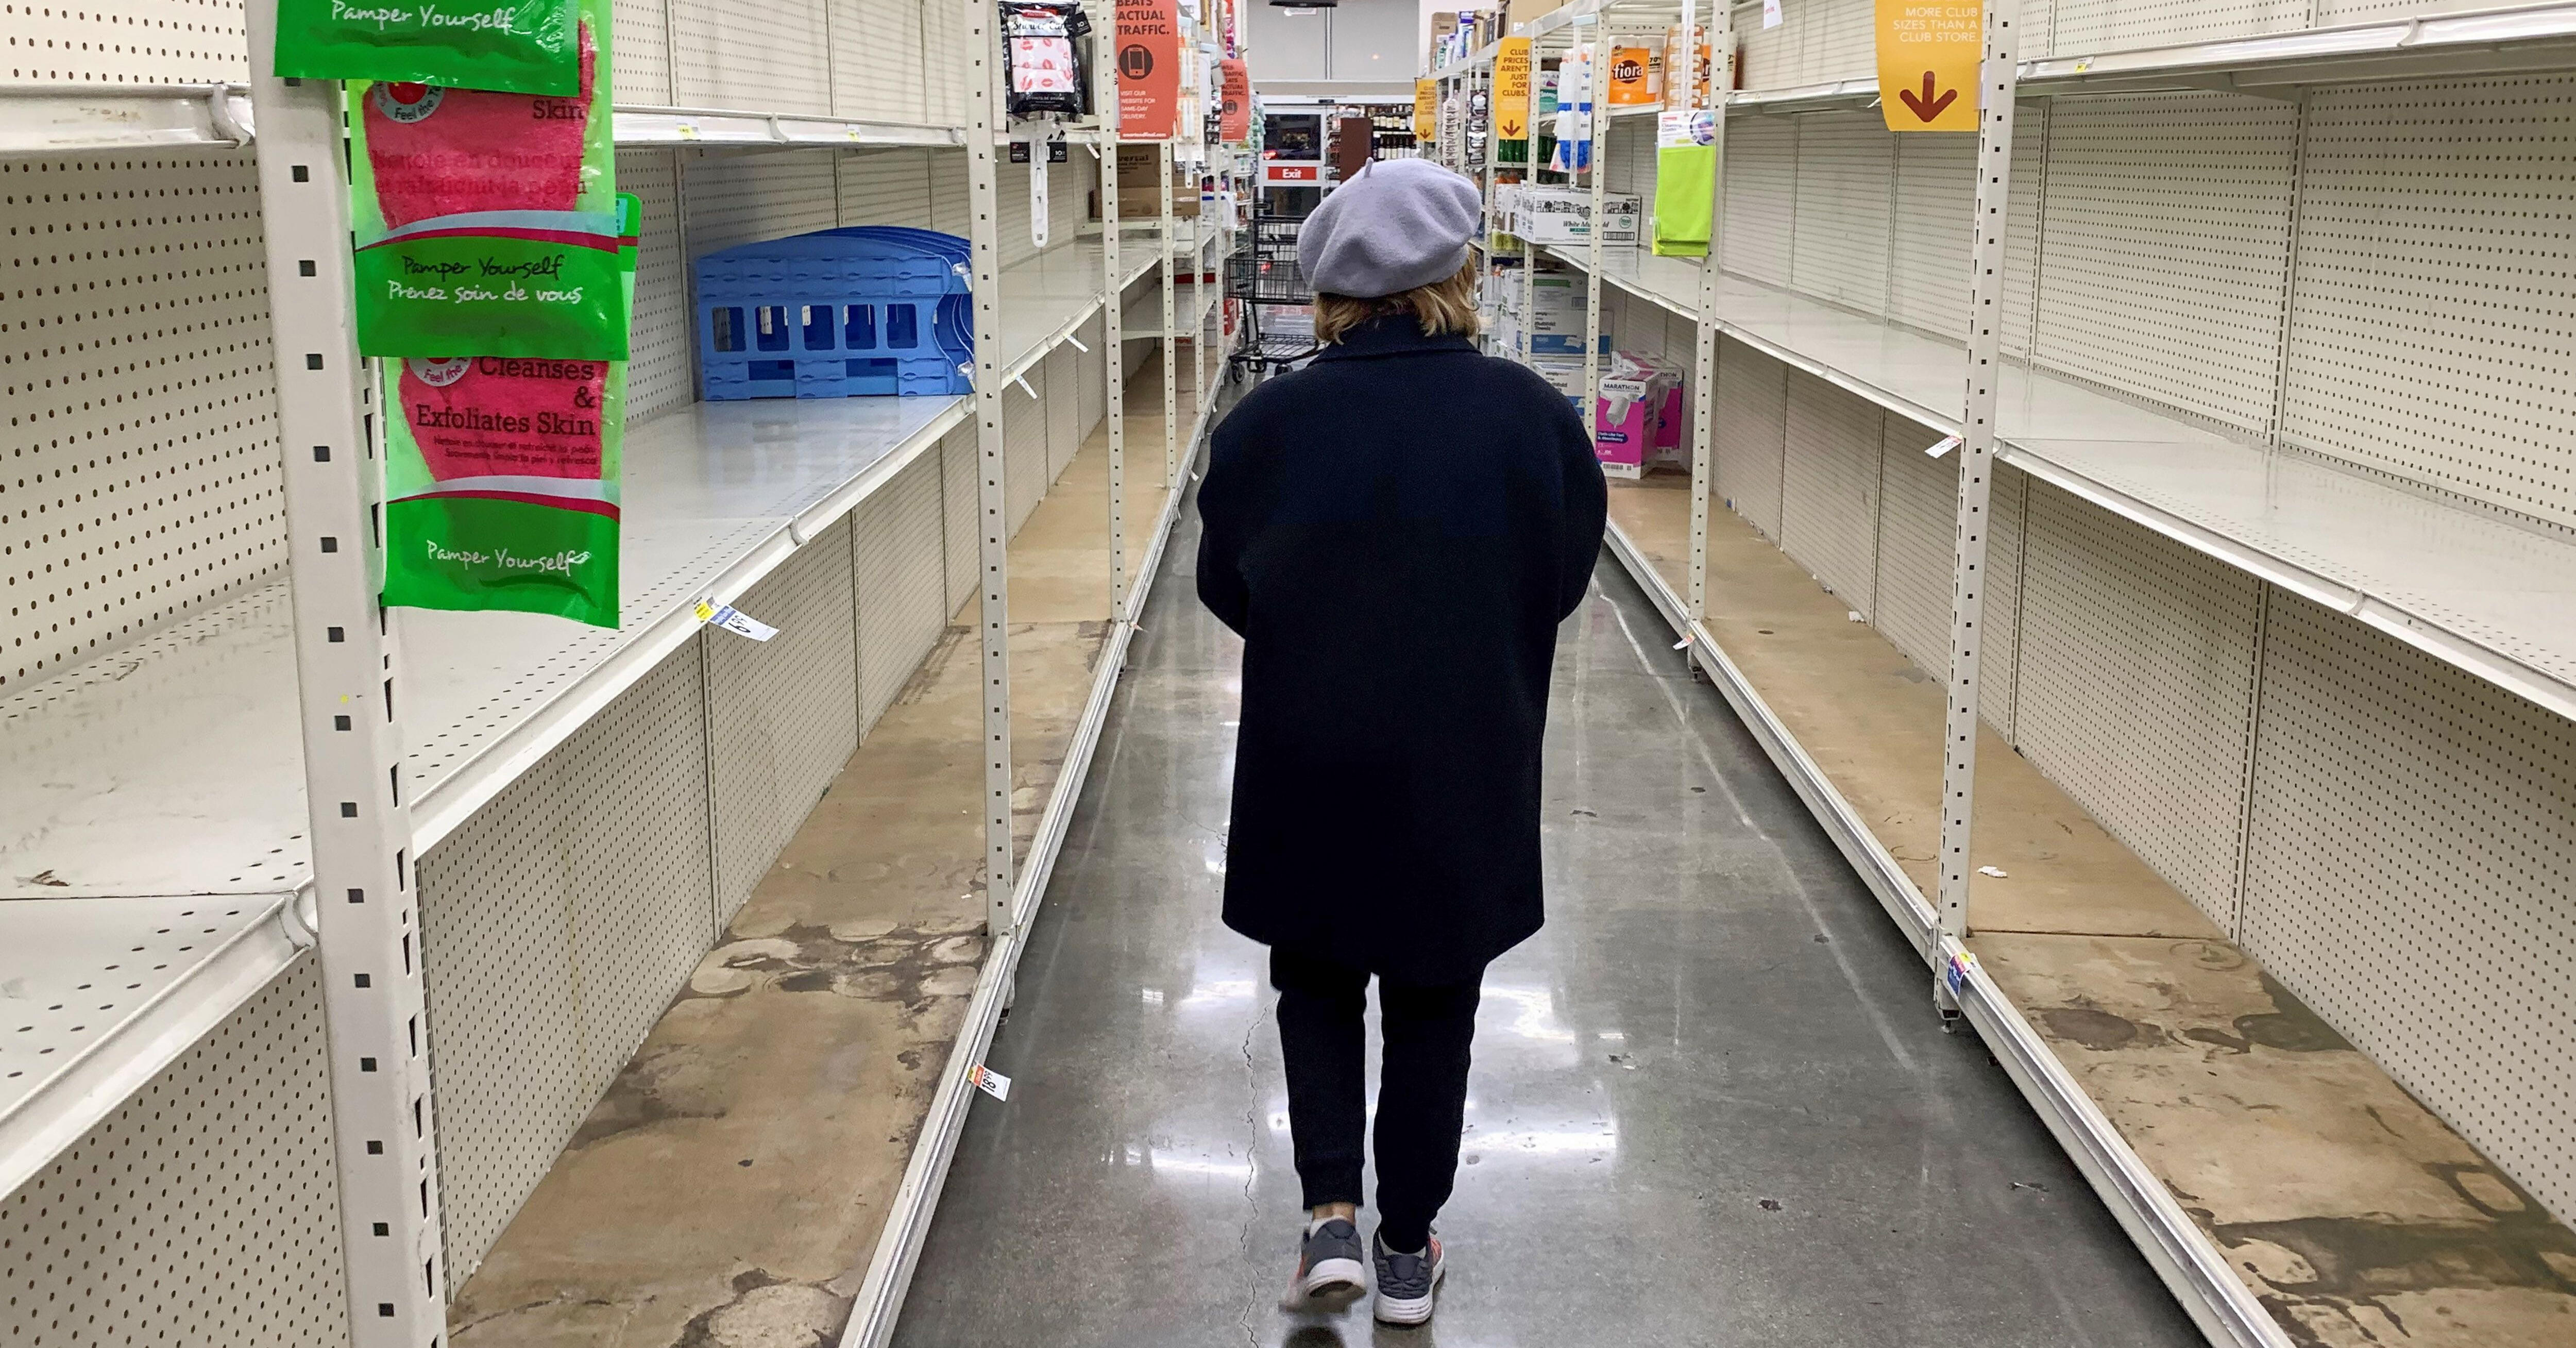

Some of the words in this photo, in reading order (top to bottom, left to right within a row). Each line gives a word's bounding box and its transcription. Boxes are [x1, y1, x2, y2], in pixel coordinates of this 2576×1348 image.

[332, 0, 413, 30] Pamper
[421, 3, 515, 34] Yourself
[1117, 10, 1165, 21] ACTUAL
[1906, 8, 1942, 18] MORE
[1946, 8, 1978, 18] CLUB
[1117, 24, 1170, 35] TRAFFIC.
[1893, 20, 1927, 30] SIZES
[1930, 20, 1965, 30] THAN
[1968, 19, 1978, 29] A
[1900, 32, 1932, 42] CLUB
[1936, 31, 1980, 42] STORE.
[1613, 62, 1643, 79] fiora
[395, 107, 417, 120] Feel
[418, 99, 434, 116] the
[533, 99, 584, 121] Skin
[1282, 168, 1302, 178] Exit
[402, 256, 471, 283] Pamper
[479, 255, 564, 281] Yourself
[388, 280, 448, 301] Prenez
[454, 284, 497, 304] soin
[503, 280, 526, 300] de
[536, 286, 583, 304] vous
[423, 368, 444, 382] Feel
[479, 357, 595, 380] Cleanses
[574, 385, 596, 409] &
[416, 403, 531, 434] Exfoliates
[537, 412, 596, 437] Skin
[426, 539, 489, 571] Pamper
[495, 548, 577, 577] Yourself
